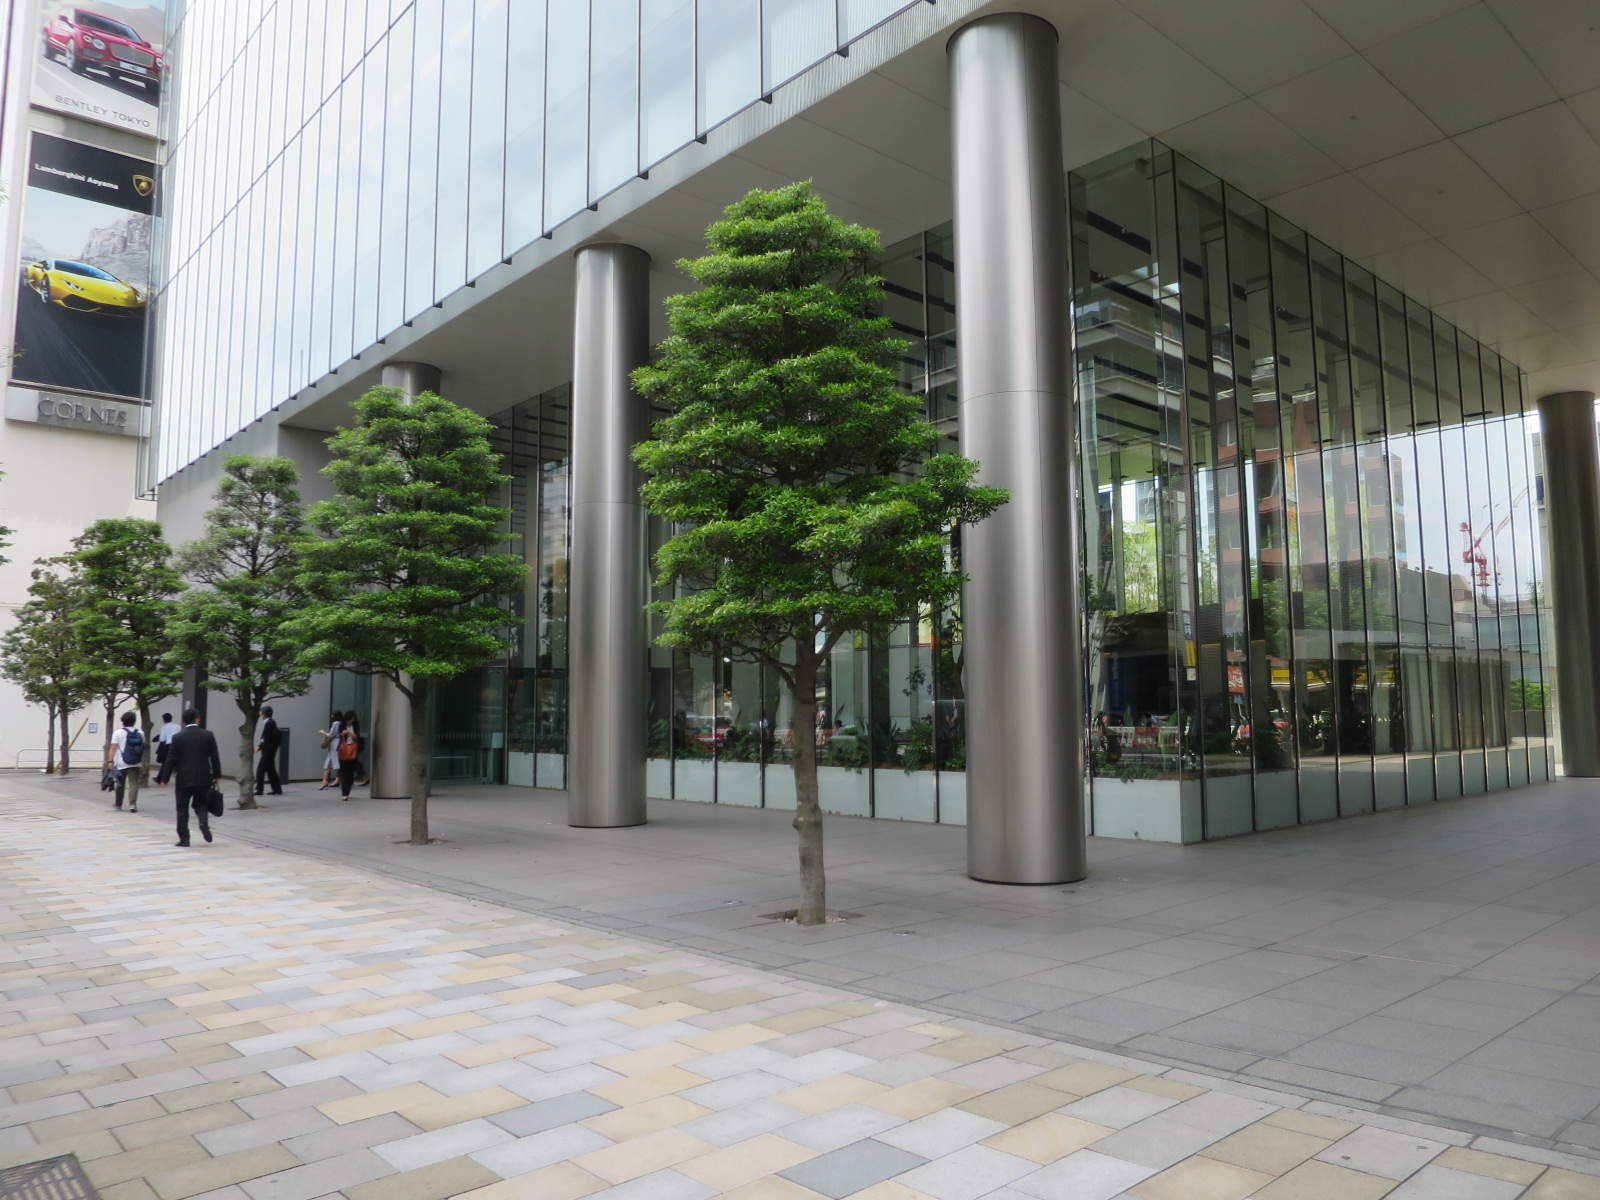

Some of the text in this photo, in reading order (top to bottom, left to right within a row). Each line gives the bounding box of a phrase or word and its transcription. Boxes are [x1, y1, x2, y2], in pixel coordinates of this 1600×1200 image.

[55, 95, 150, 127] BENTLEY TOKYO
[34, 163, 118, 189] Lamborghini Aoyama
[38, 399, 128, 427] CORNES
